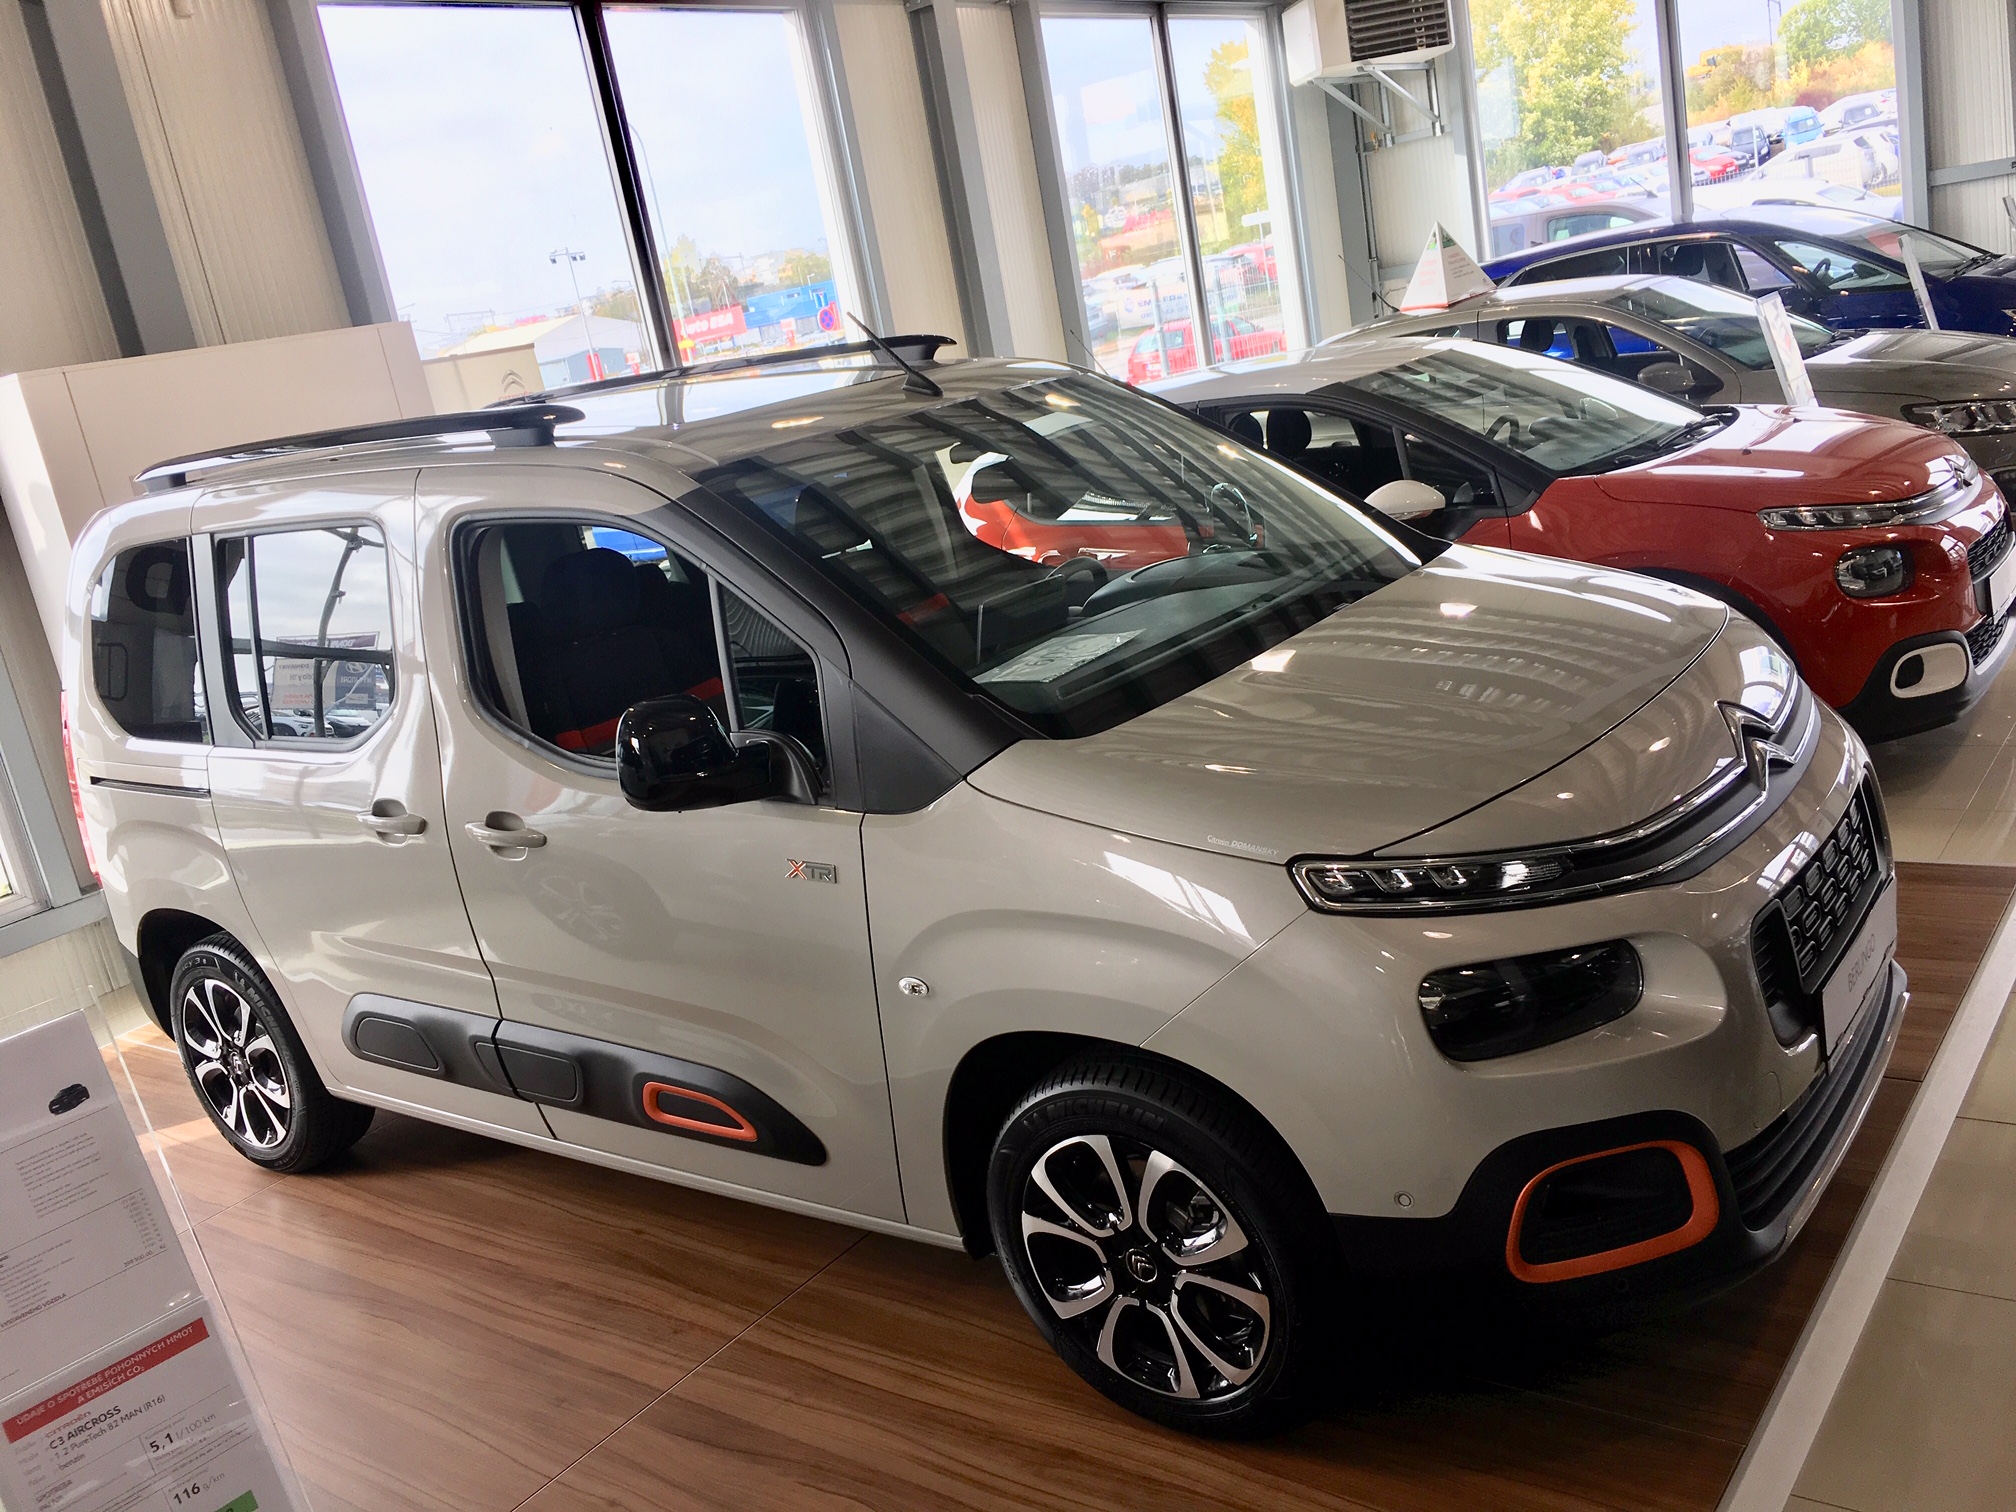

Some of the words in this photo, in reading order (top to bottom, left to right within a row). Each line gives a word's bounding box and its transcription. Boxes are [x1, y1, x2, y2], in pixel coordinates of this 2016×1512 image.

[784, 859, 833, 882] XTR
[1847, 933, 1876, 993] BERLINGO
[48, 1399, 56, 1410] O
[104, 1341, 166, 1380] POHONNÝCH
[165, 1325, 195, 1347] HMOT
[77, 1393, 86, 1404] A
[85, 1371, 127, 1400] EMISÍCH
[49, 1434, 66, 1451] C3
[66, 1404, 122, 1443] AIRCROSS
[69, 1424, 109, 1453] PureTech
[107, 1418, 120, 1432] 82
[119, 1406, 144, 1426] MAN
[142, 1393, 167, 1416] (R16)
[149, 1432, 175, 1455] 5,1
[201, 1412, 217, 1425] km
[173, 1482, 202, 1506] 116
[202, 1471, 226, 1492] g/km
